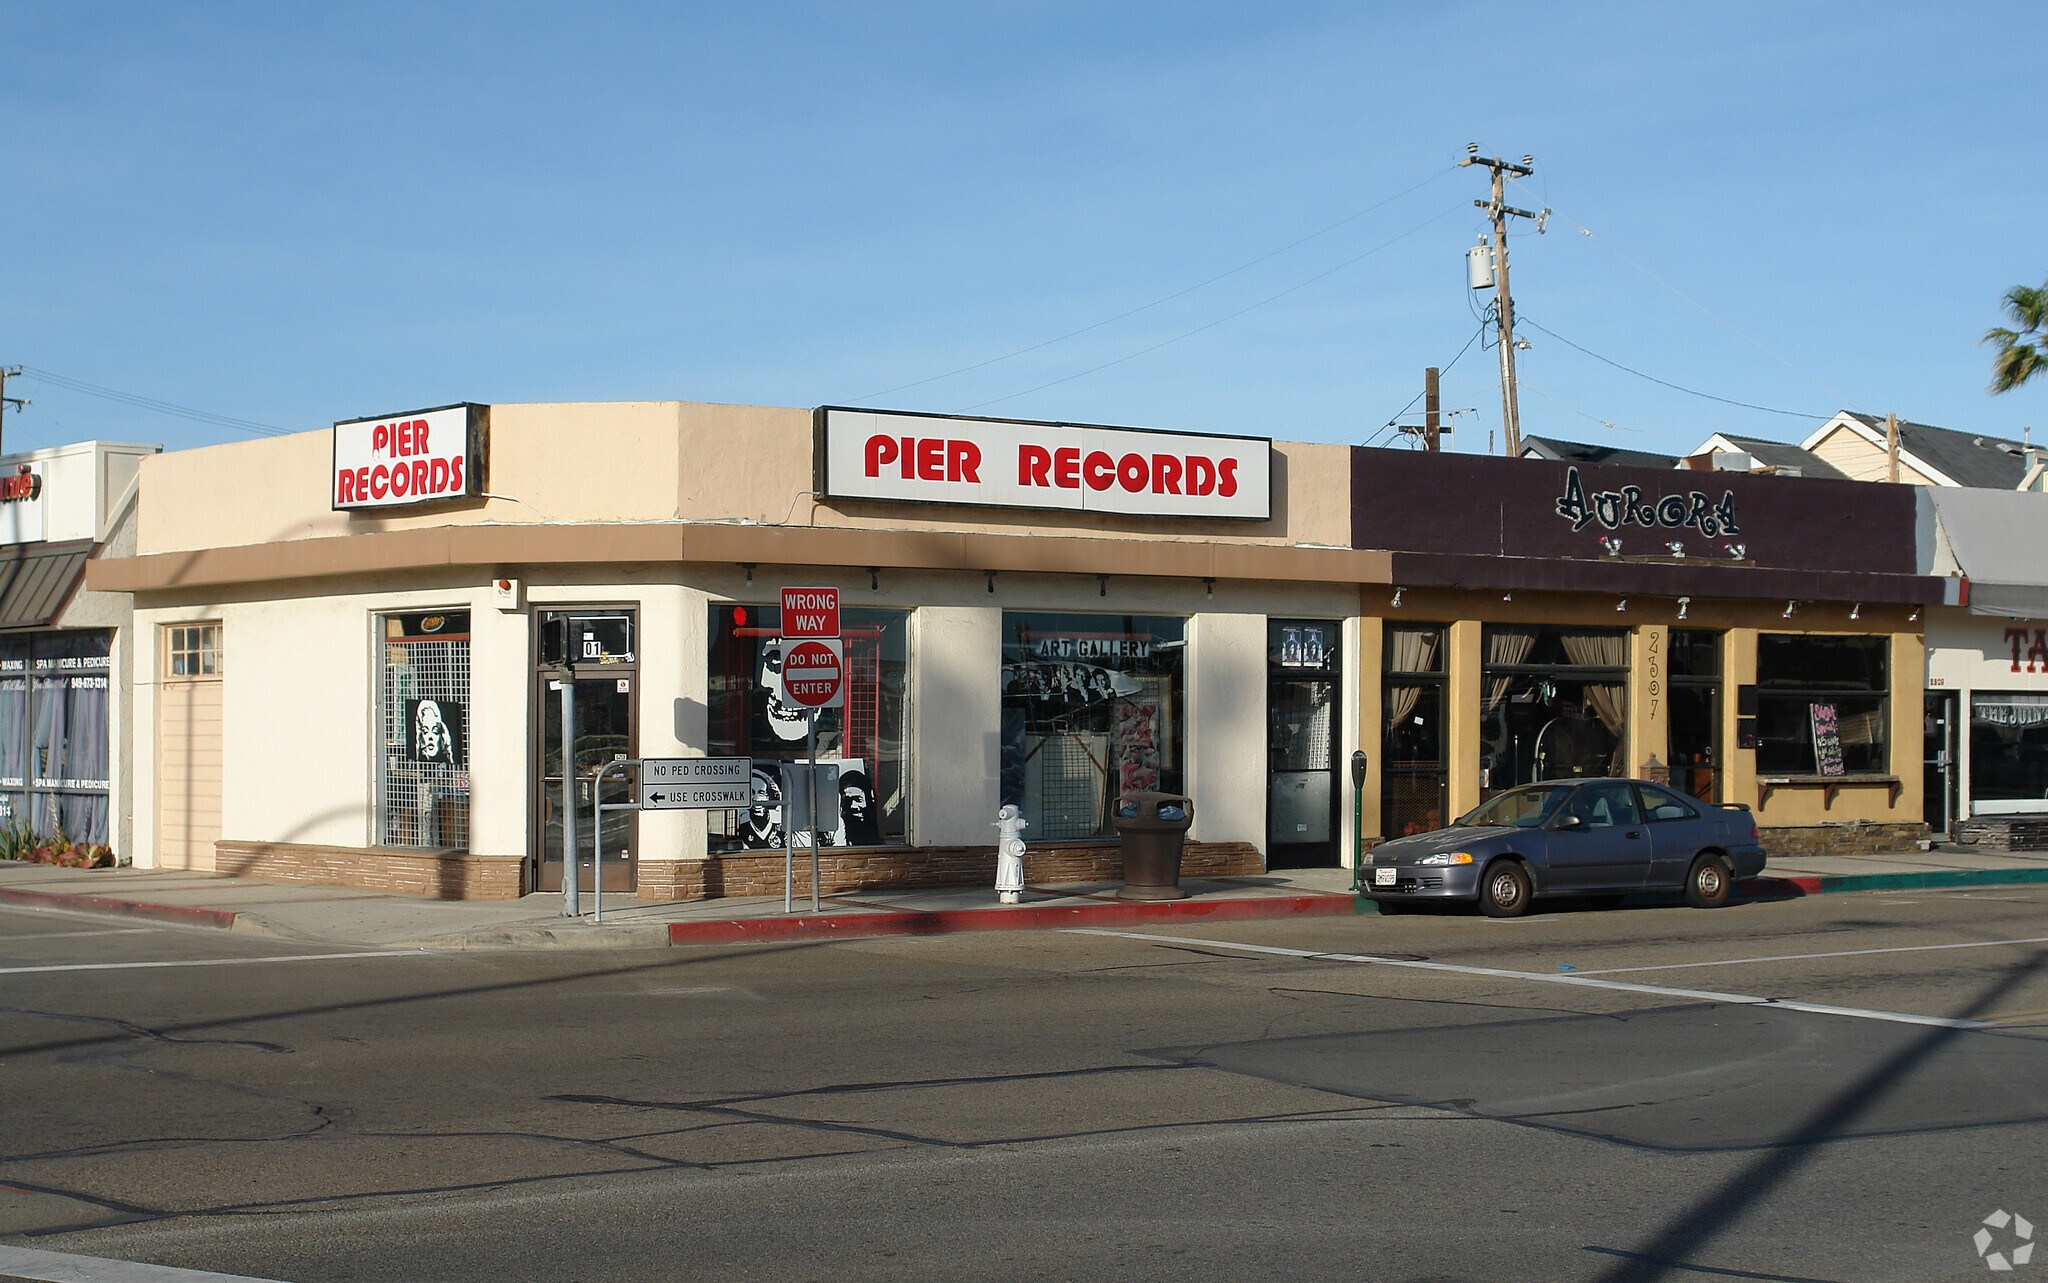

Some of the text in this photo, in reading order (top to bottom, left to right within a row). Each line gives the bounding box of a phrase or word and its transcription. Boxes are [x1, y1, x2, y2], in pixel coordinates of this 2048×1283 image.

[372, 419, 430, 459] PIER
[864, 434, 1240, 498] PIER RECORDS
[338, 456, 463, 503] RECORDS
[1556, 466, 1740, 538] AURORA
[785, 594, 835, 610] WRONG
[796, 615, 827, 631] WAY
[586, 642, 600, 655] 01
[1041, 640, 1149, 657] ART GALLERY
[1, 660, 23, 670] WAXING
[36, 659, 48, 670] SPA
[83, 656, 110, 668] PEDICURE
[790, 653, 833, 666] DO NOT
[793, 683, 832, 695] ENTER
[1980, 705, 2007, 725] THE
[654, 765, 740, 776] NO PED CROSSING
[2, 778, 23, 787] WAXING
[35, 778, 46, 788] SPA
[81, 779, 110, 790] PEDICURE
[670, 791, 745, 802] USE CROSSWALK
